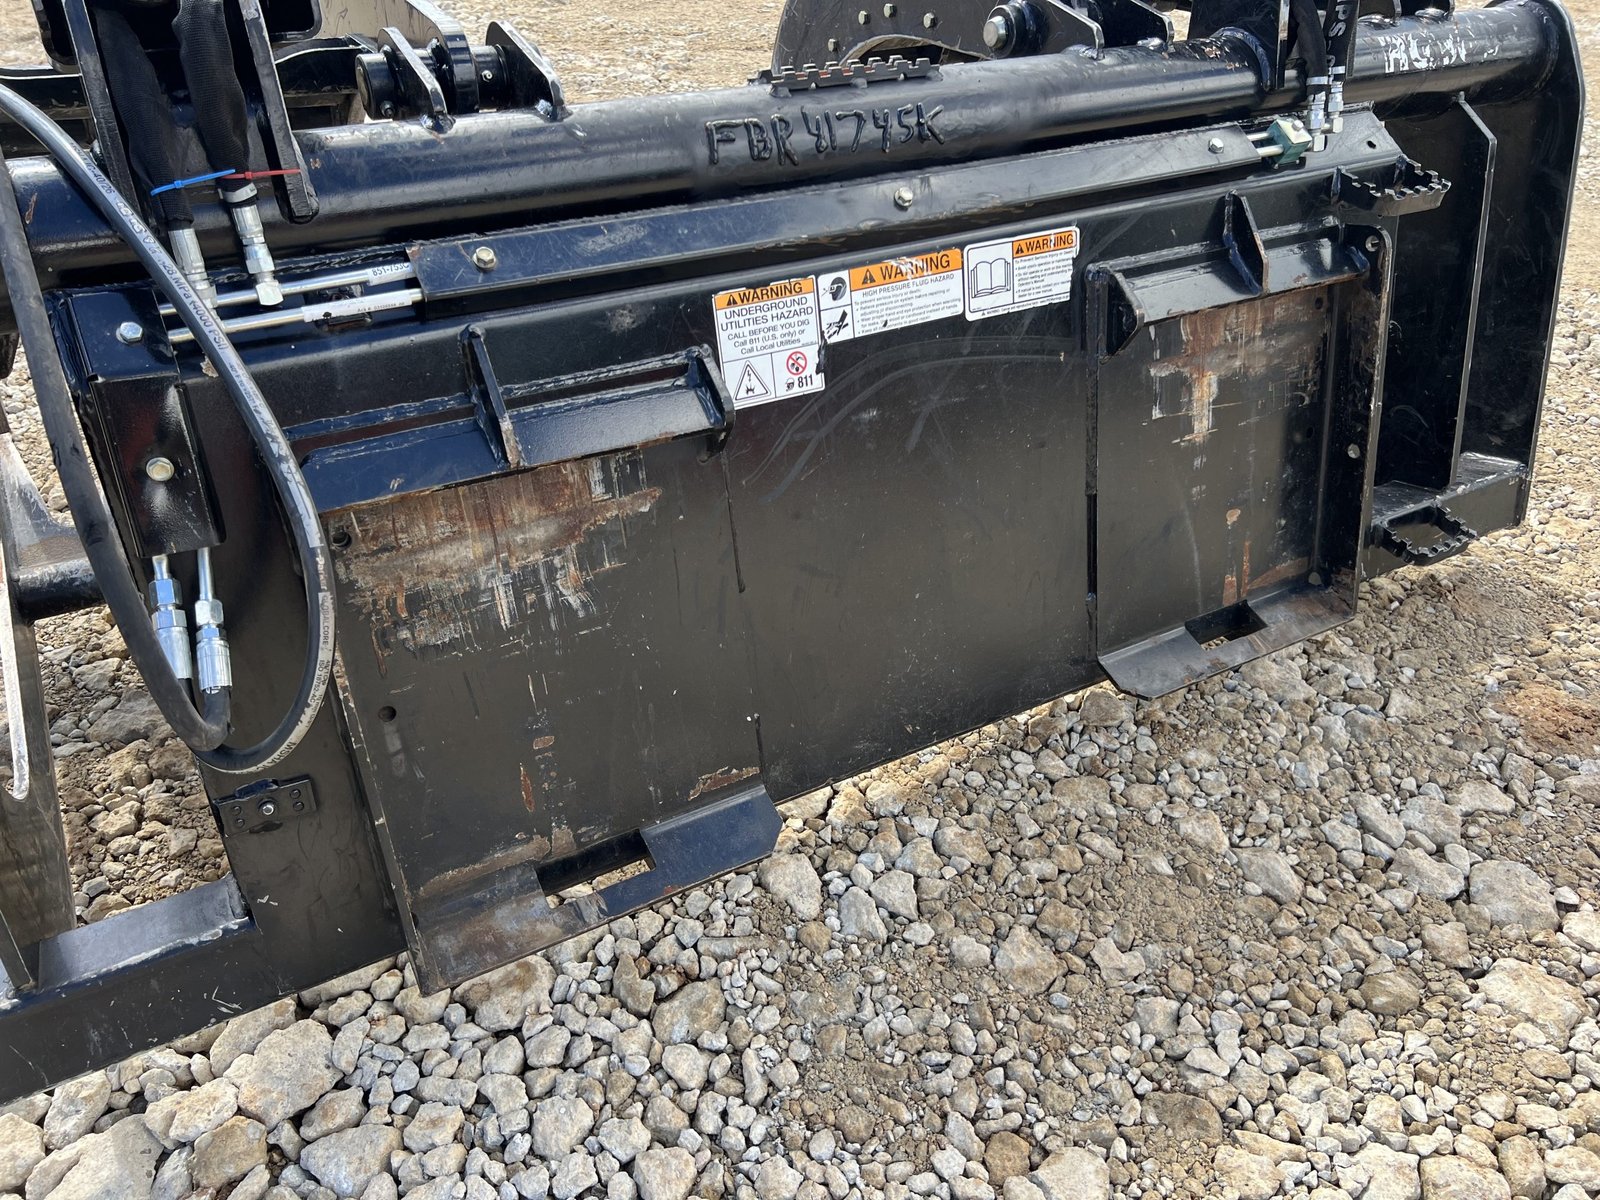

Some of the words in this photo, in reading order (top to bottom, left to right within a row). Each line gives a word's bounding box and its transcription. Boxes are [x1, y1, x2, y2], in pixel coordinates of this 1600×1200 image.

[1025, 234, 1073, 252] WARNING
[739, 282, 802, 302] WARNING
[862, 288, 878, 297] HIGH
[879, 282, 910, 293] PRESSURE
[912, 278, 929, 287] FLUID
[931, 274, 954, 283] HAZARD
[725, 297, 808, 319] UNDERGROUND
[721, 315, 768, 332] UTILITIES
[771, 307, 813, 322] HAZARD
[728, 332, 747, 341] CALL
[749, 325, 778, 337] BEFORE
[780, 322, 795, 330] YOU
[798, 319, 810, 327] DIG
[734, 339, 747, 348] Call
[762, 333, 778, 344] (U.S.
[780, 330, 796, 341] only)
[741, 346, 754, 354] Call
[756, 342, 775, 351] Local
[776, 338, 800, 348] Utilities
[798, 375, 813, 388] 811
[320, 595, 330, 645] GLOBALCORE
[318, 659, 326, 672] ISO
[267, 741, 297, 767] MSHA
